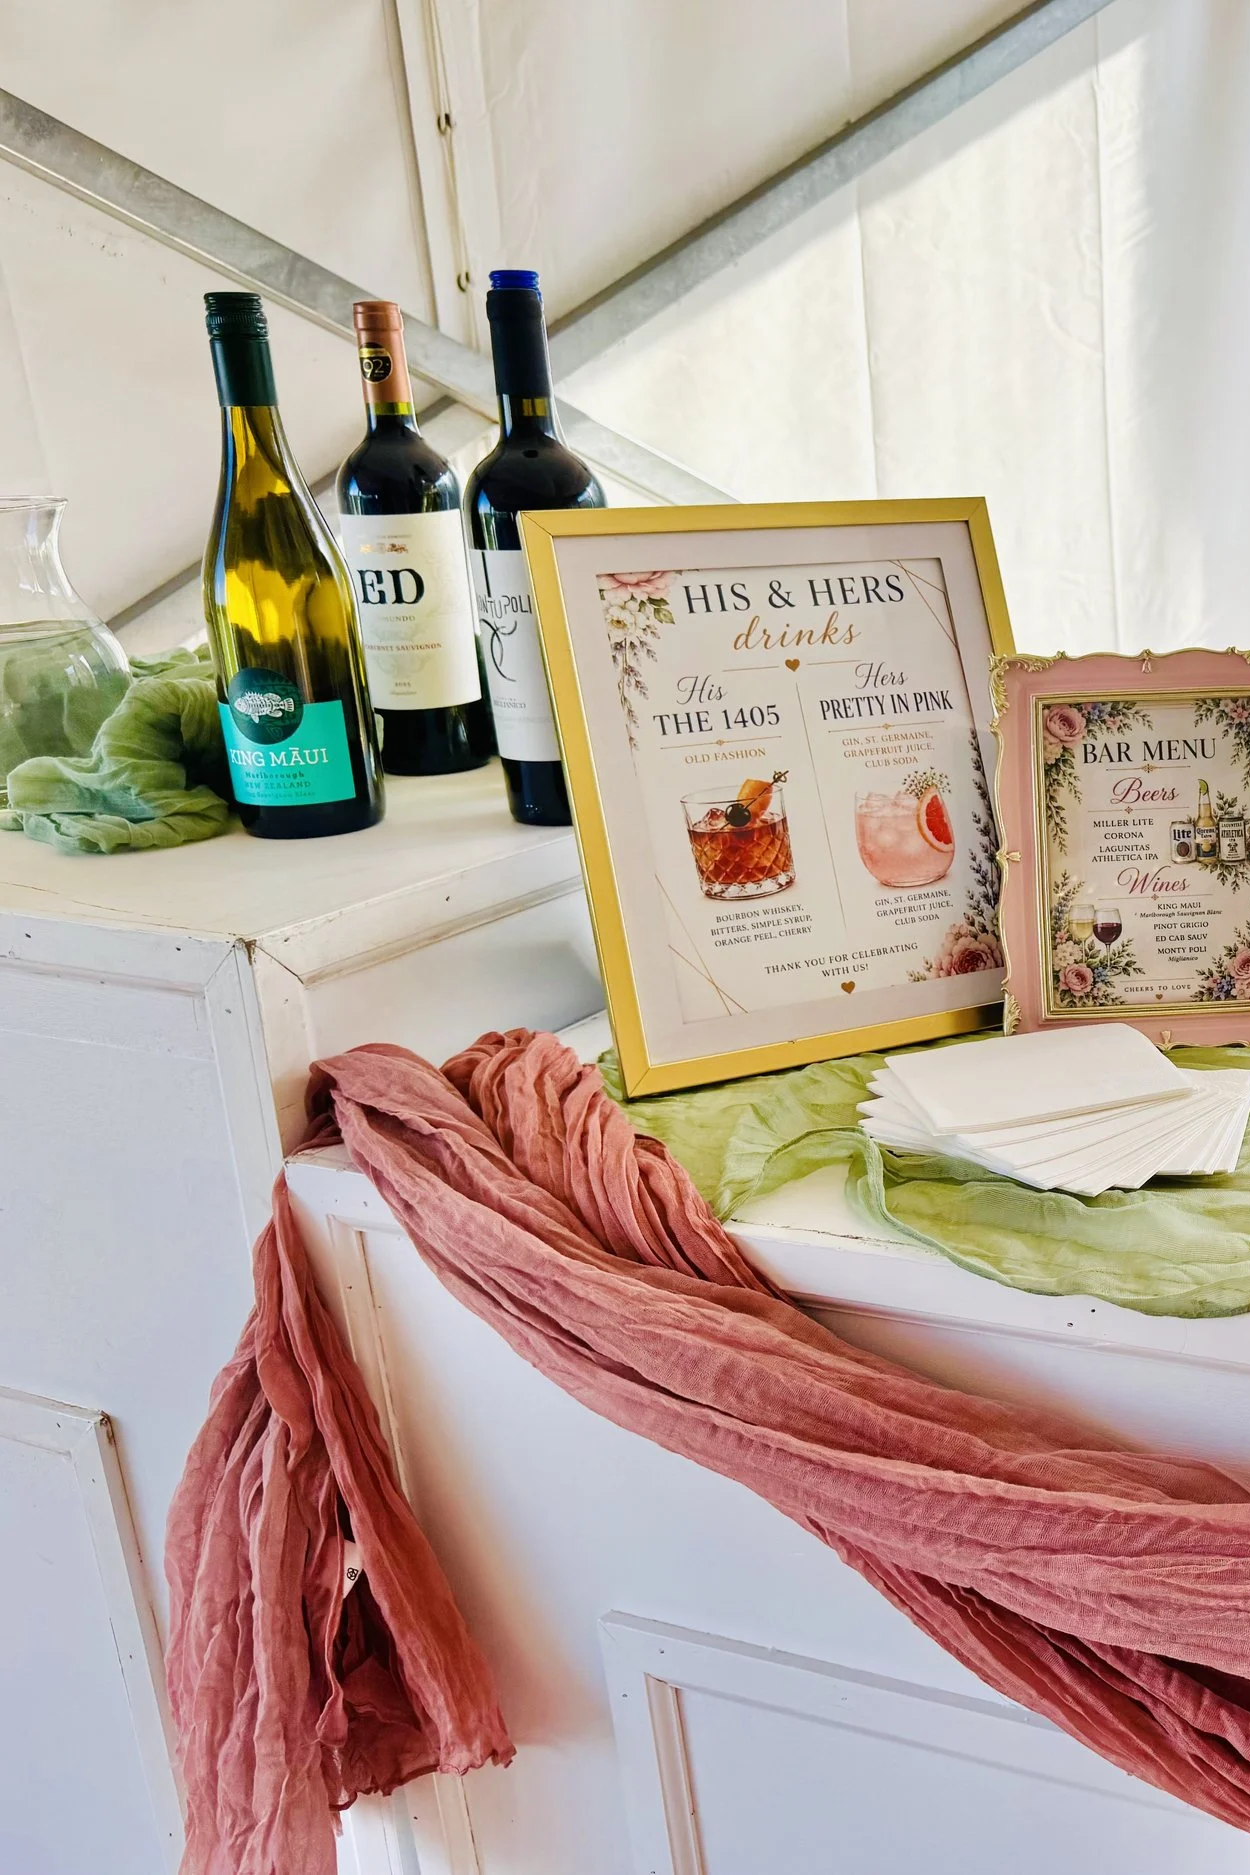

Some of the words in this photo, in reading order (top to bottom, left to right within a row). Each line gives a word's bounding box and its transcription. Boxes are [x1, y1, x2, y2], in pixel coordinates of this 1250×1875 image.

[356, 568, 425, 605] ED
[683, 582, 752, 614] HIS
[767, 579, 797, 609] &
[808, 574, 905, 607] HERS
[478, 594, 533, 619] ONTUPOLI
[733, 611, 862, 651] drinks
[396, 643, 442, 651] SAUVIGNON
[854, 661, 909, 690] Hers
[676, 675, 729, 705] His
[819, 694, 887, 721] PRETTY
[890, 693, 911, 714] IN
[913, 690, 953, 713] PINK
[653, 710, 713, 737] THE
[722, 704, 781, 731] 1405
[842, 736, 862, 747] GIN,
[864, 734, 878, 745] ST.
[880, 730, 934, 744] GERMAINE,
[230, 749, 265, 767] KING
[269, 747, 328, 766] MĀUI
[684, 752, 710, 764] OLD
[714, 747, 767, 762] FASHION
[843, 744, 903, 759] GRAPEFRUIT
[906, 741, 935, 754] JUICE,
[1083, 742, 1132, 764] BAR
[1142, 738, 1217, 761] MENU
[865, 757, 890, 769] CLUB
[893, 755, 919, 767] SODA
[264, 780, 311, 789] ZEALAND
[1110, 776, 1180, 805] Beers
[1093, 819, 1129, 828] MILLER
[1132, 818, 1154, 826] LITE
[1104, 831, 1144, 840] CORONA
[1173, 829, 1192, 841] Lite
[1092, 853, 1143, 863] ATHLETICA
[1145, 852, 1159, 861] IPA
[1099, 844, 1150, 853] LAGUNITAS
[1117, 865, 1190, 894] Wines
[874, 897, 893, 907] GIN,
[894, 895, 906, 905] ST.
[907, 889, 951, 903] GERMAINE,
[716, 910, 760, 923] BOURBON
[762, 904, 804, 918] WHISKEY,
[876, 905, 927, 919] GRAPEFRUIT
[929, 900, 954, 912] JUICE,
[710, 924, 750, 937] BITTERS,
[751, 920, 783, 932] SIMPLE
[784, 914, 813, 927] SYRUP,
[894, 917, 917, 927] CLUB
[918, 913, 940, 923] SODA
[1153, 922, 1177, 930] PINOT
[1180, 921, 1209, 929] GRIGIO
[714, 934, 752, 947] ORANGE
[754, 931, 778, 943] PEEL,
[779, 925, 813, 939] CHERRY
[1168, 934, 1185, 942] CAB
[1187, 933, 1208, 941] SAUV
[764, 962, 802, 975] THANK
[804, 957, 827, 969] YOU
[829, 953, 850, 965] FOR
[851, 942, 919, 961] CELEBRATING
[821, 966, 850, 978] WITH
[852, 963, 869, 973] US!
[1124, 985, 1154, 993] CHEERS
